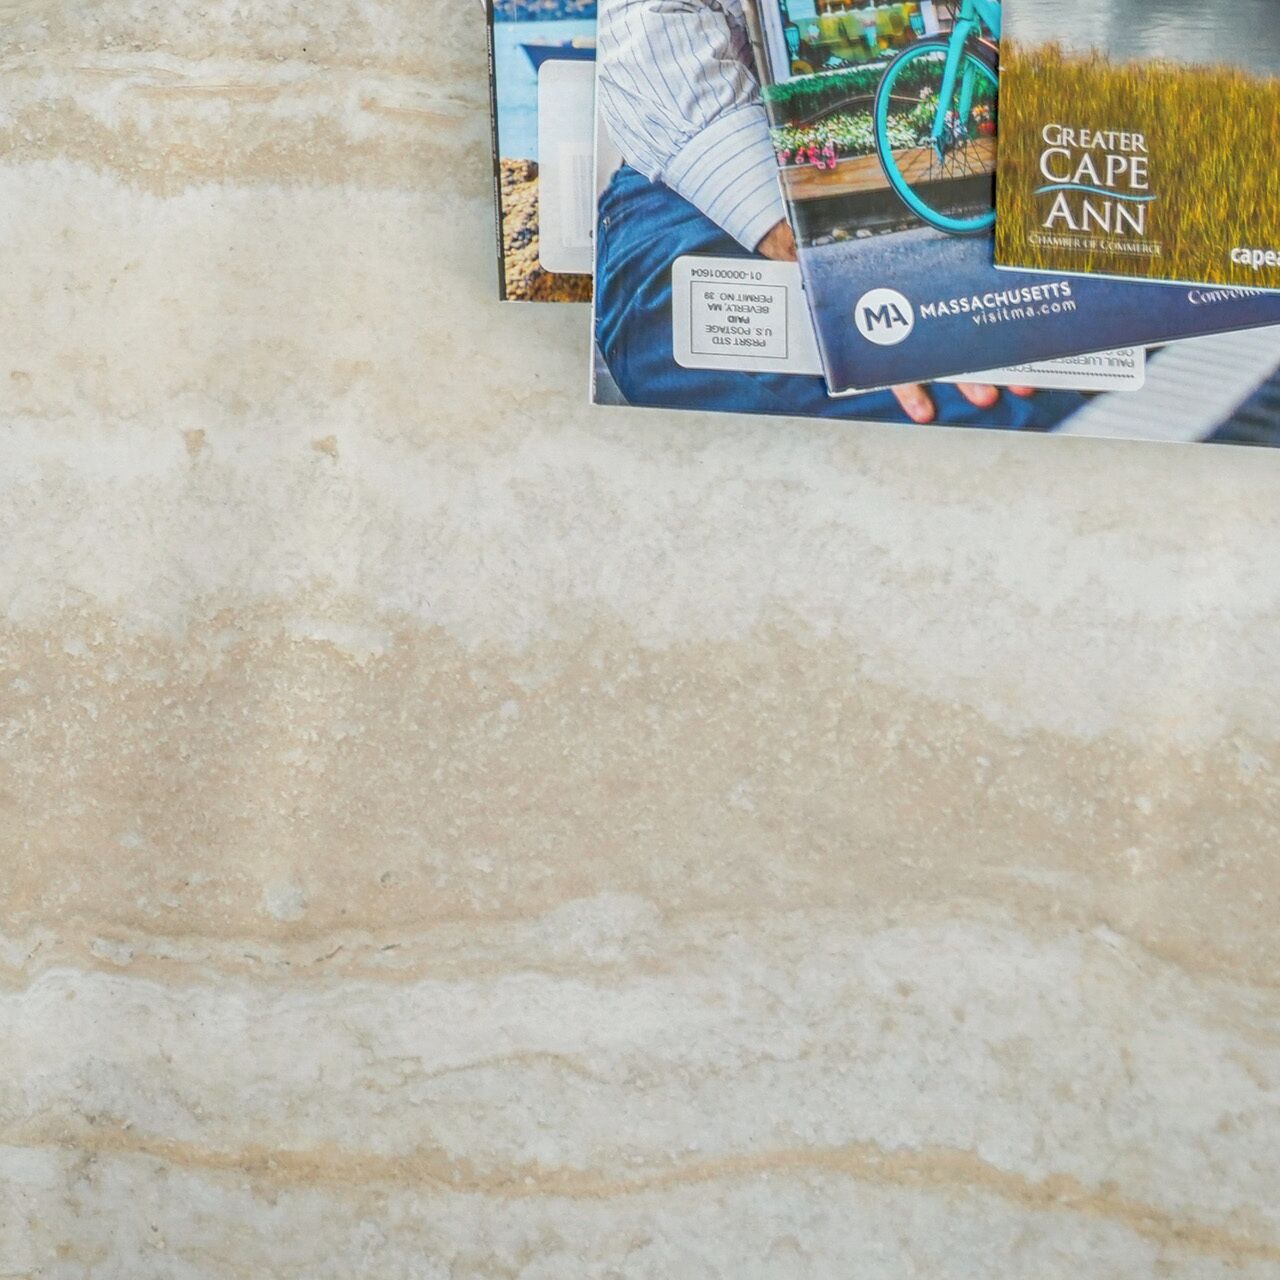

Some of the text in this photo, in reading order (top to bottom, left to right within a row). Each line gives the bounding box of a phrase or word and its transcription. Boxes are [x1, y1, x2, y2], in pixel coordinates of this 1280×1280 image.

[1042, 123, 1149, 153] GREATER
[1040, 147, 1149, 190] CAPE
[1041, 191, 1147, 236] ANN
[1231, 247, 1280, 271] cape
[704, 292, 715, 300] 39
[737, 294, 773, 303] PERMIT
[707, 303, 769, 314] BEVERLY, MA
[863, 281, 1072, 331] MA MASSACHUSETTS
[972, 300, 1076, 326] visitma.com
[727, 315, 750, 324] PAID
[705, 325, 751, 335] POSTAGE
[712, 336, 766, 347] PRSRT STD
[1104, 357, 1135, 368] PAUL
